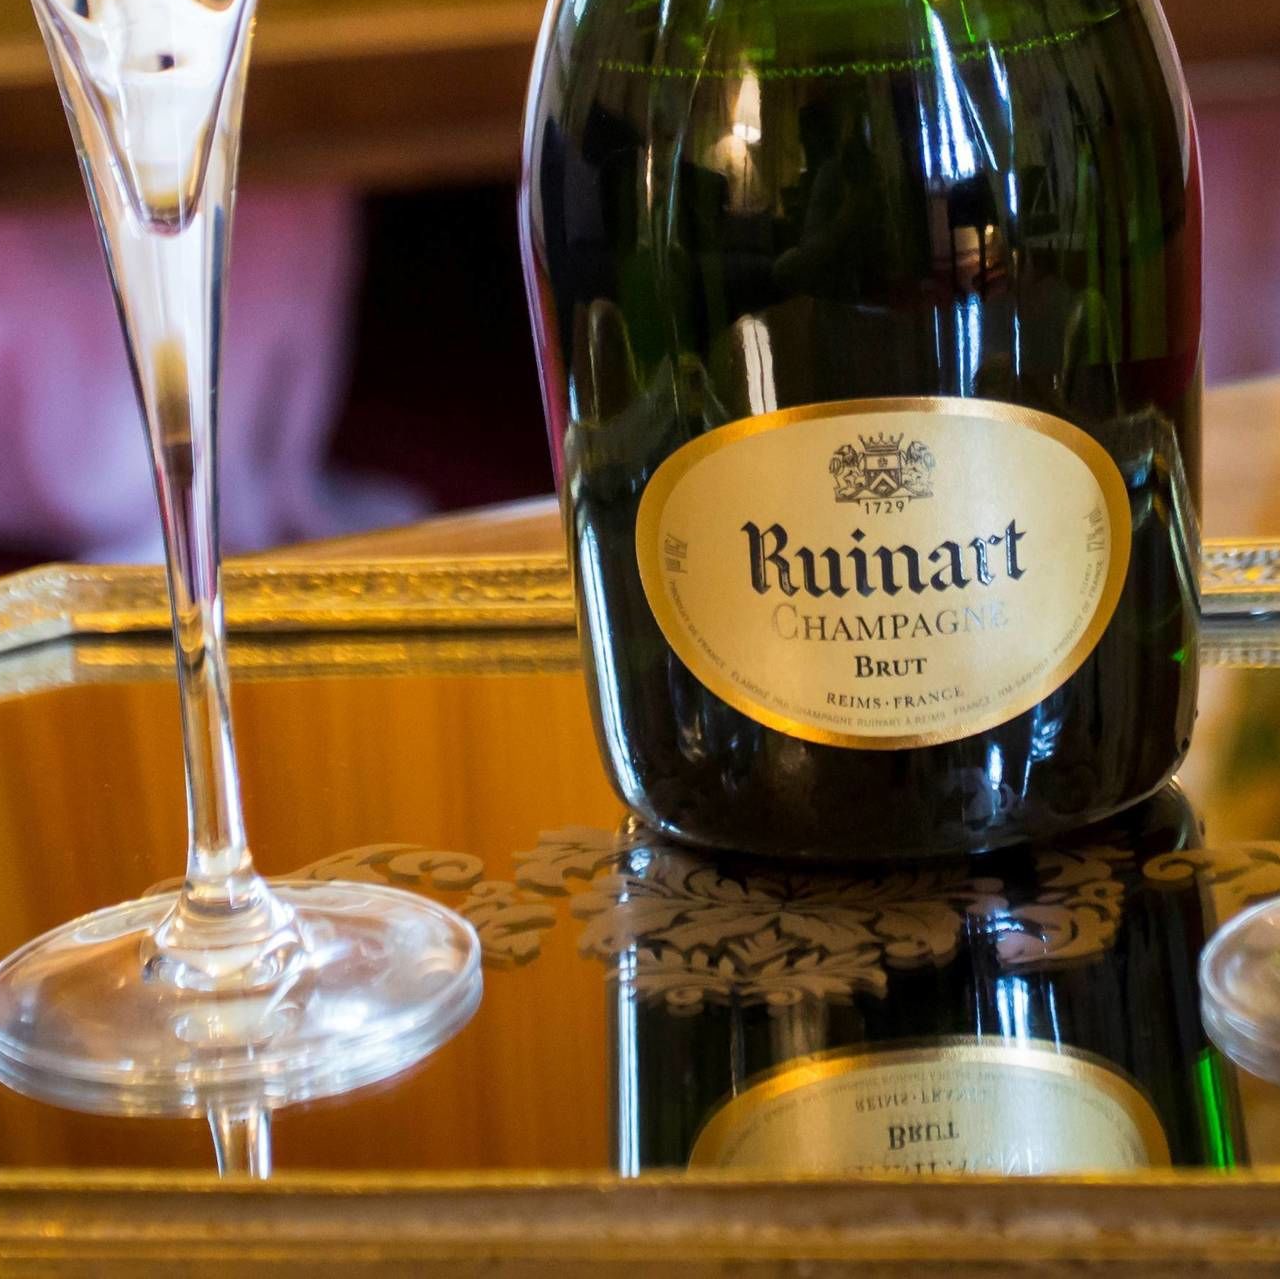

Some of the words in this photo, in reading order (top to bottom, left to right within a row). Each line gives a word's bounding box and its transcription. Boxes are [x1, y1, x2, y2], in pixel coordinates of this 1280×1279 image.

[864, 501, 905, 515] 1729
[740, 519, 1027, 599] Ruinart
[773, 600, 1009, 641] CHAMPAGNE
[854, 655, 928, 678] BRUT
[826, 692, 881, 710] REIMS
[894, 686, 964, 710] FRANCE
